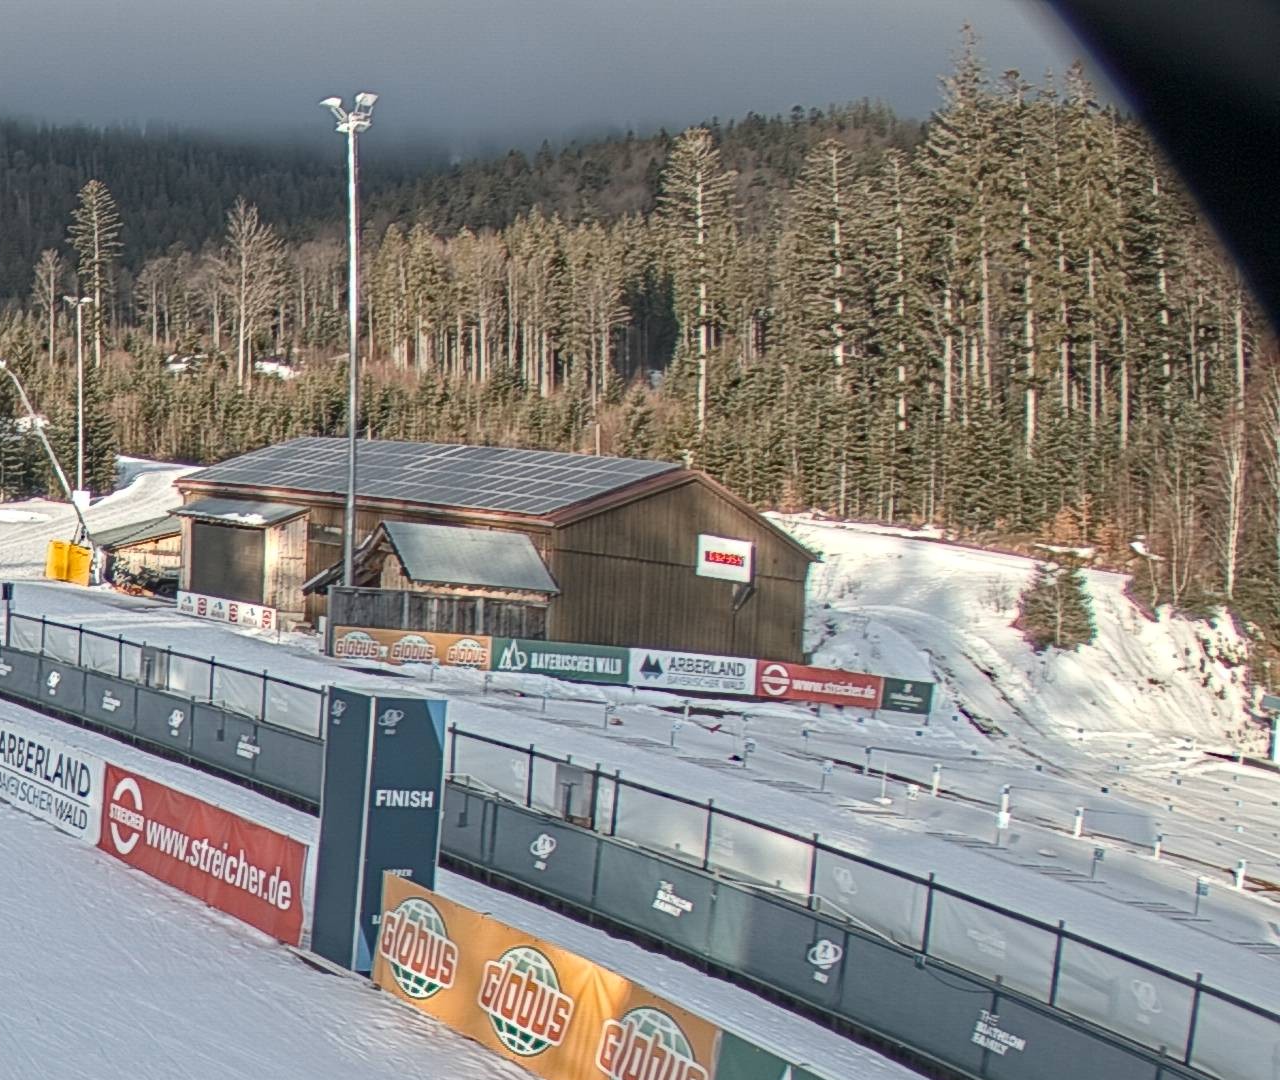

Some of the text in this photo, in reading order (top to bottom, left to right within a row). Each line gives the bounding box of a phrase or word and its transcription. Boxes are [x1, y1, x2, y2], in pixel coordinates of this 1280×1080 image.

[531, 652, 622, 674] BAYERISCHER WALD
[668, 656, 746, 677] ARBERLAND
[376, 789, 434, 808] FINISH
[52, 799, 88, 830] WALD
[146, 819, 292, 910] www.streicher.de
